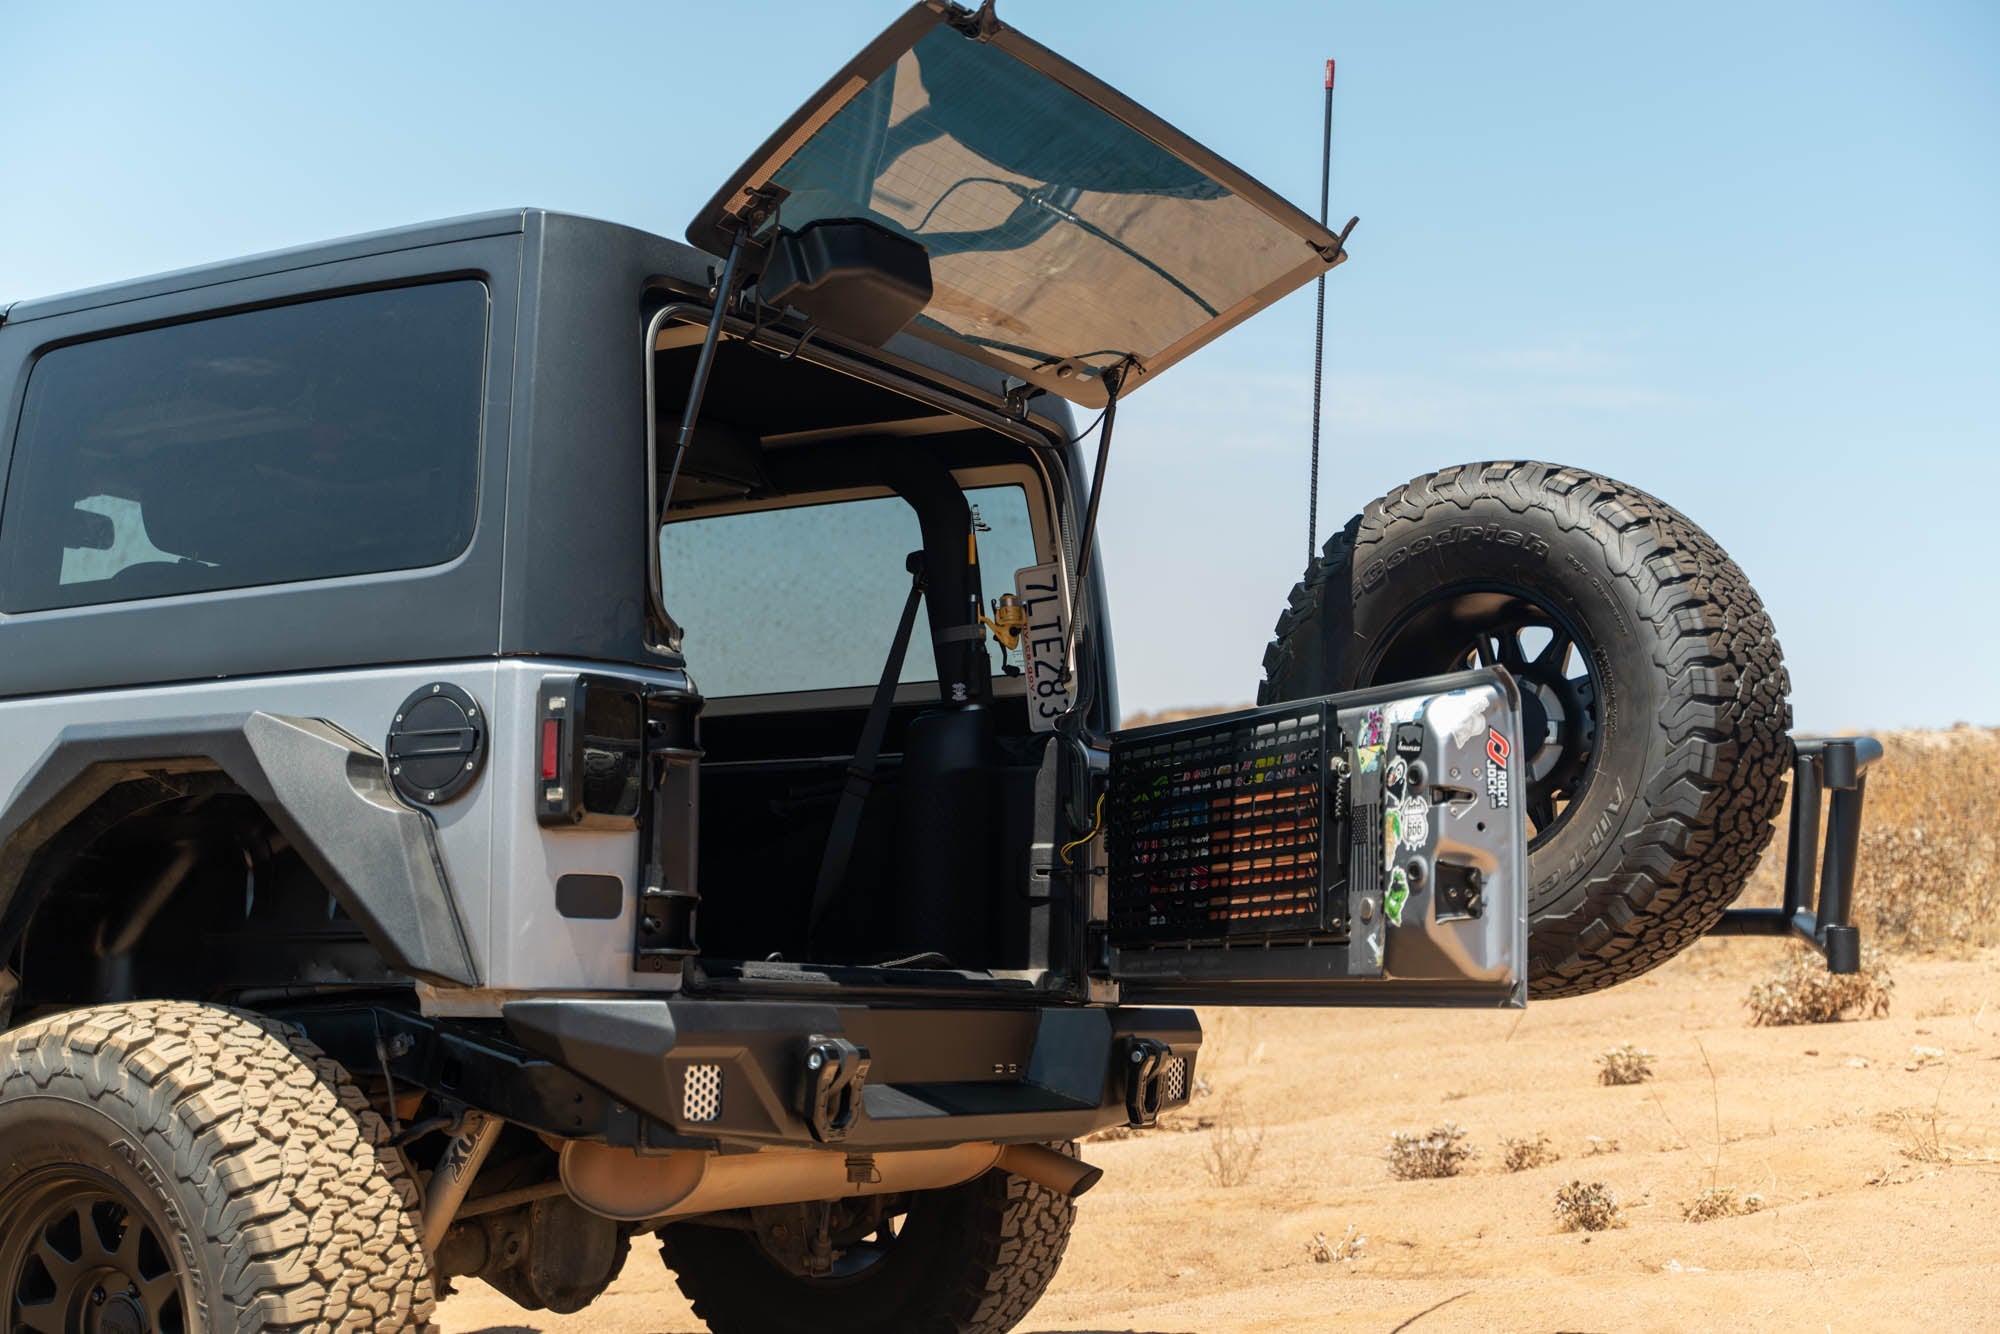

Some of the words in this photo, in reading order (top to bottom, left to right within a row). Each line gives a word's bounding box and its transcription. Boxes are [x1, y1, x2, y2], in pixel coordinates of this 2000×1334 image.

[1025, 574, 1070, 718] 7LTE283
[1486, 759, 1497, 795] JOCK
[1498, 770, 1508, 807] ROCK
